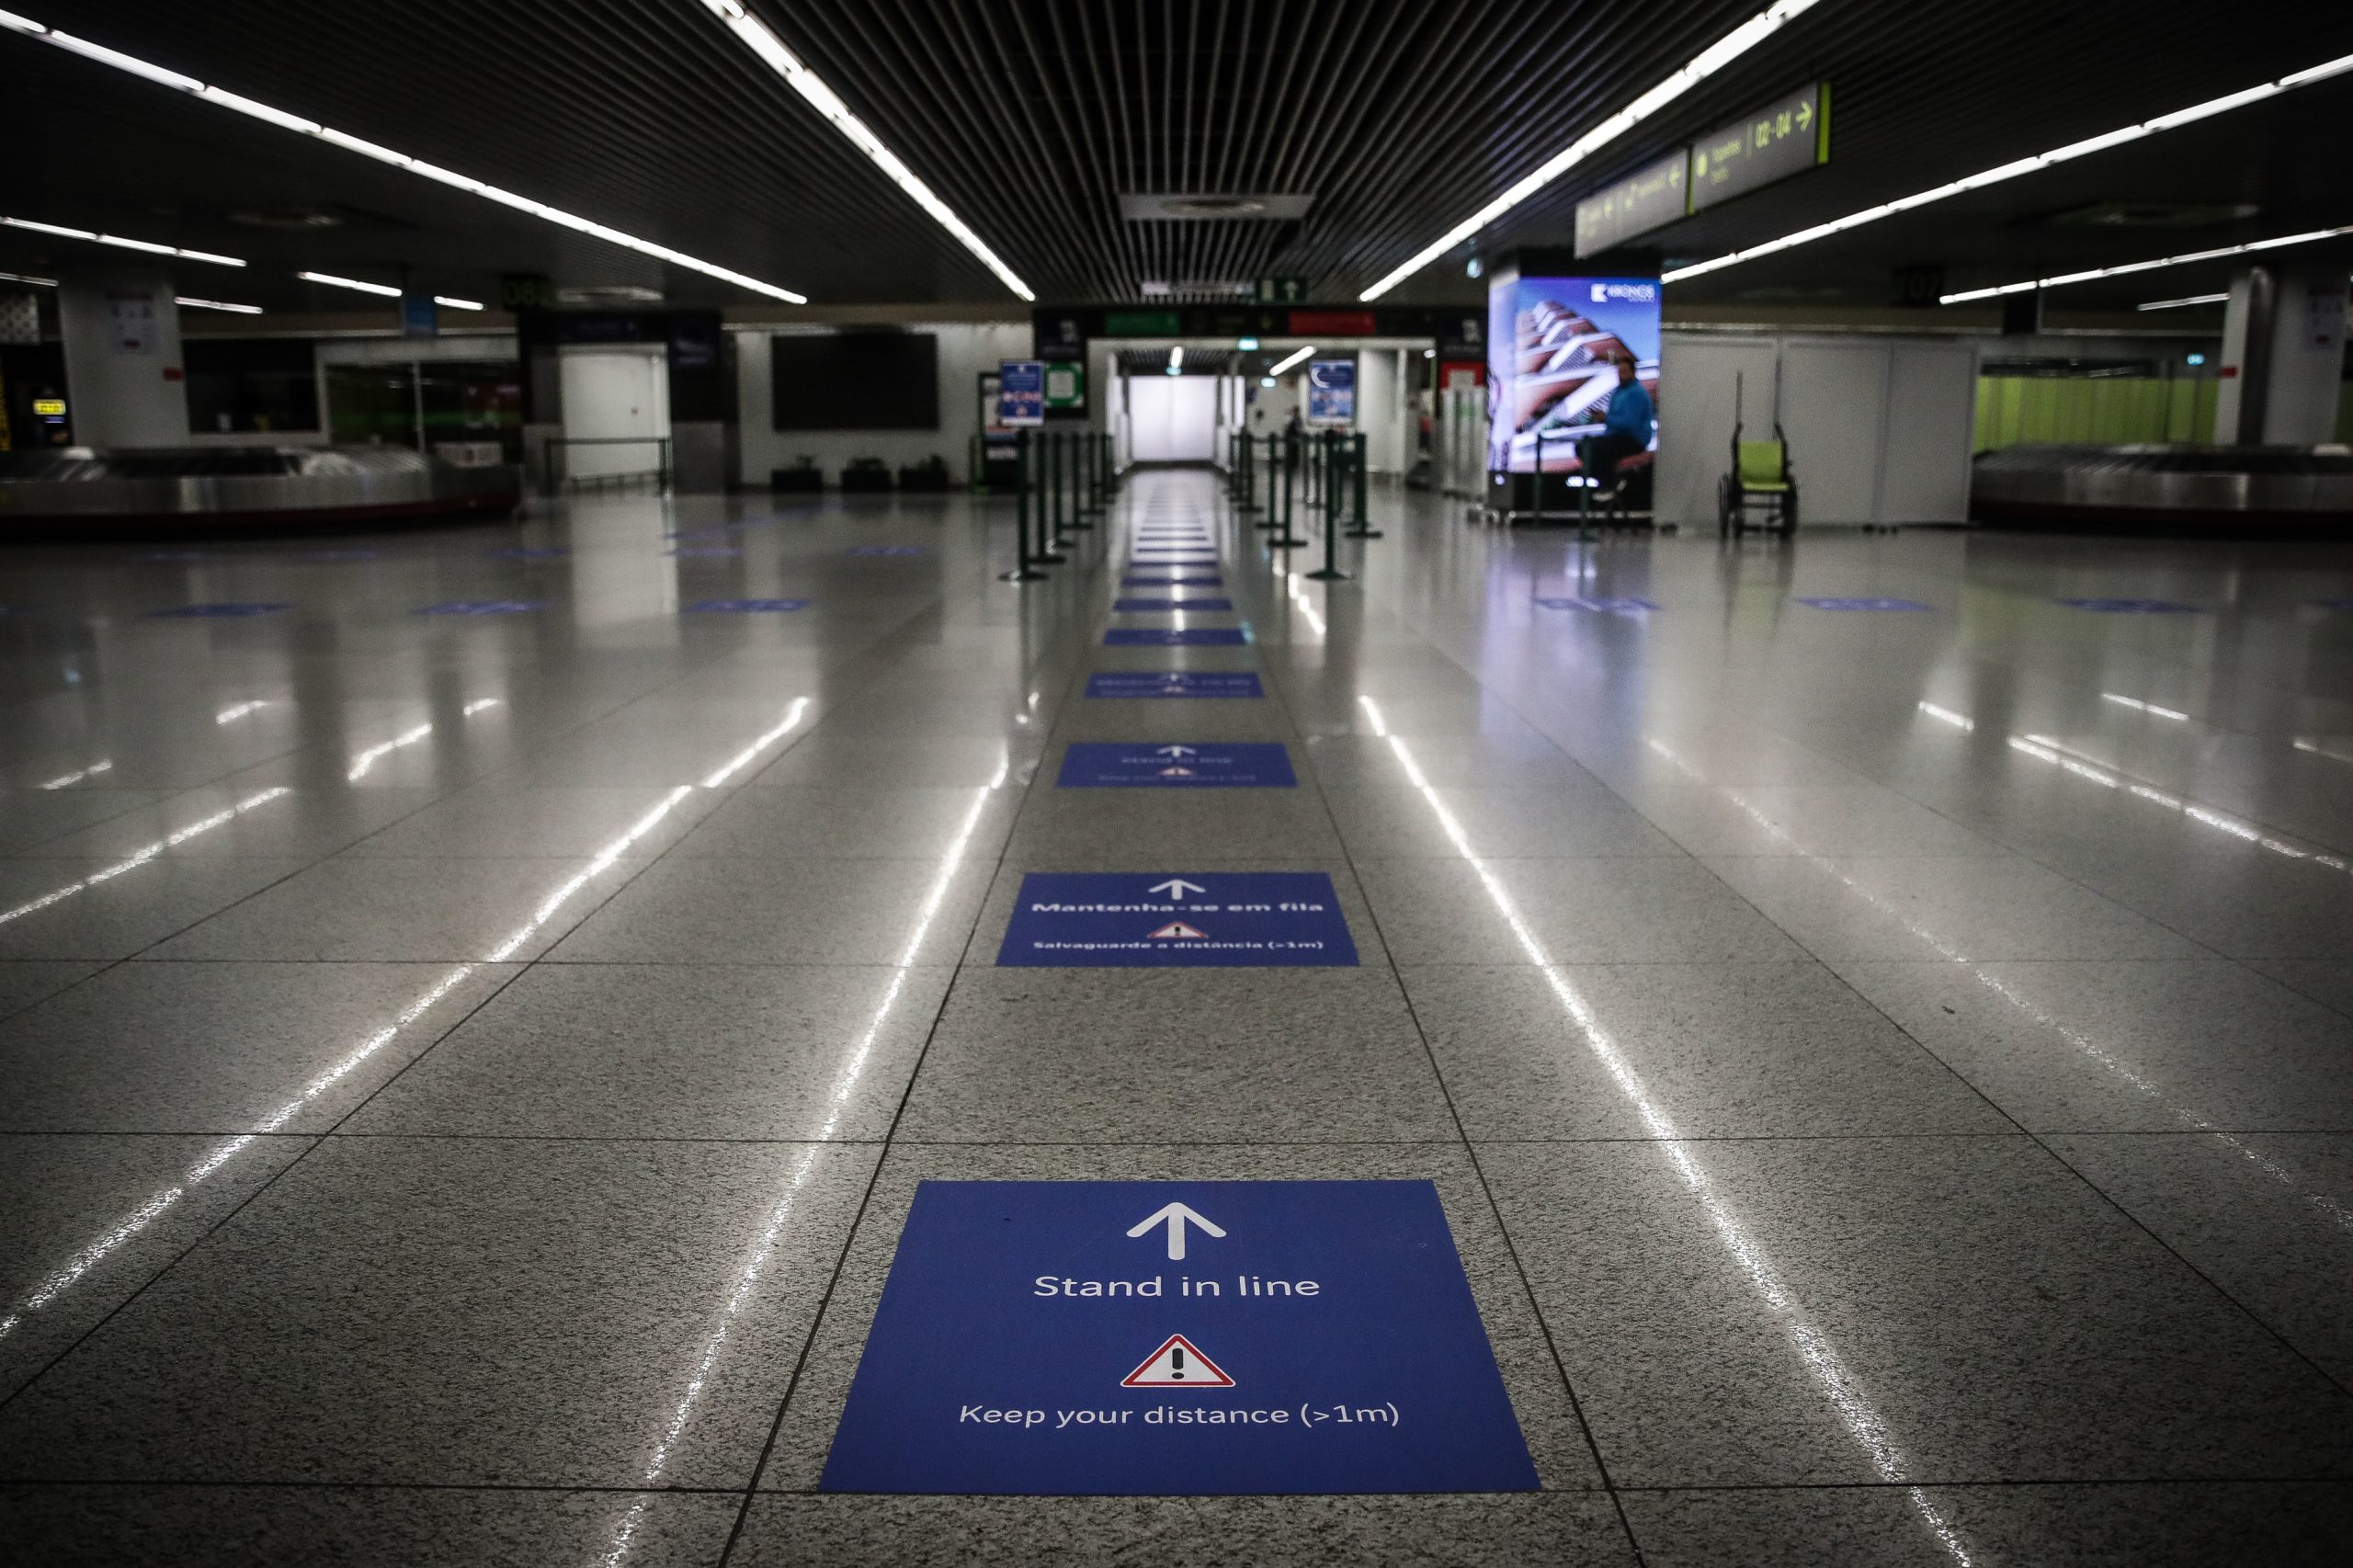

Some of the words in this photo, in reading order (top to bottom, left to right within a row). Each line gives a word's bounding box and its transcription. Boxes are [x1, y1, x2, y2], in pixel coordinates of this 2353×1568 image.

[1031, 902, 1220, 913] Mantenha-se
[1227, 903, 1271, 913] em
[1279, 902, 1324, 913] fila
[1033, 940, 1153, 951] Salvaguarde
[1033, 1275, 1162, 1297] Stand
[1182, 1276, 1221, 1297] in
[1239, 1275, 1321, 1297] line
[960, 1404, 1046, 1428] Keep
[1055, 1410, 1133, 1428] your
[1143, 1405, 1290, 1424] distance
[1300, 1402, 1400, 1428] (>1m)
